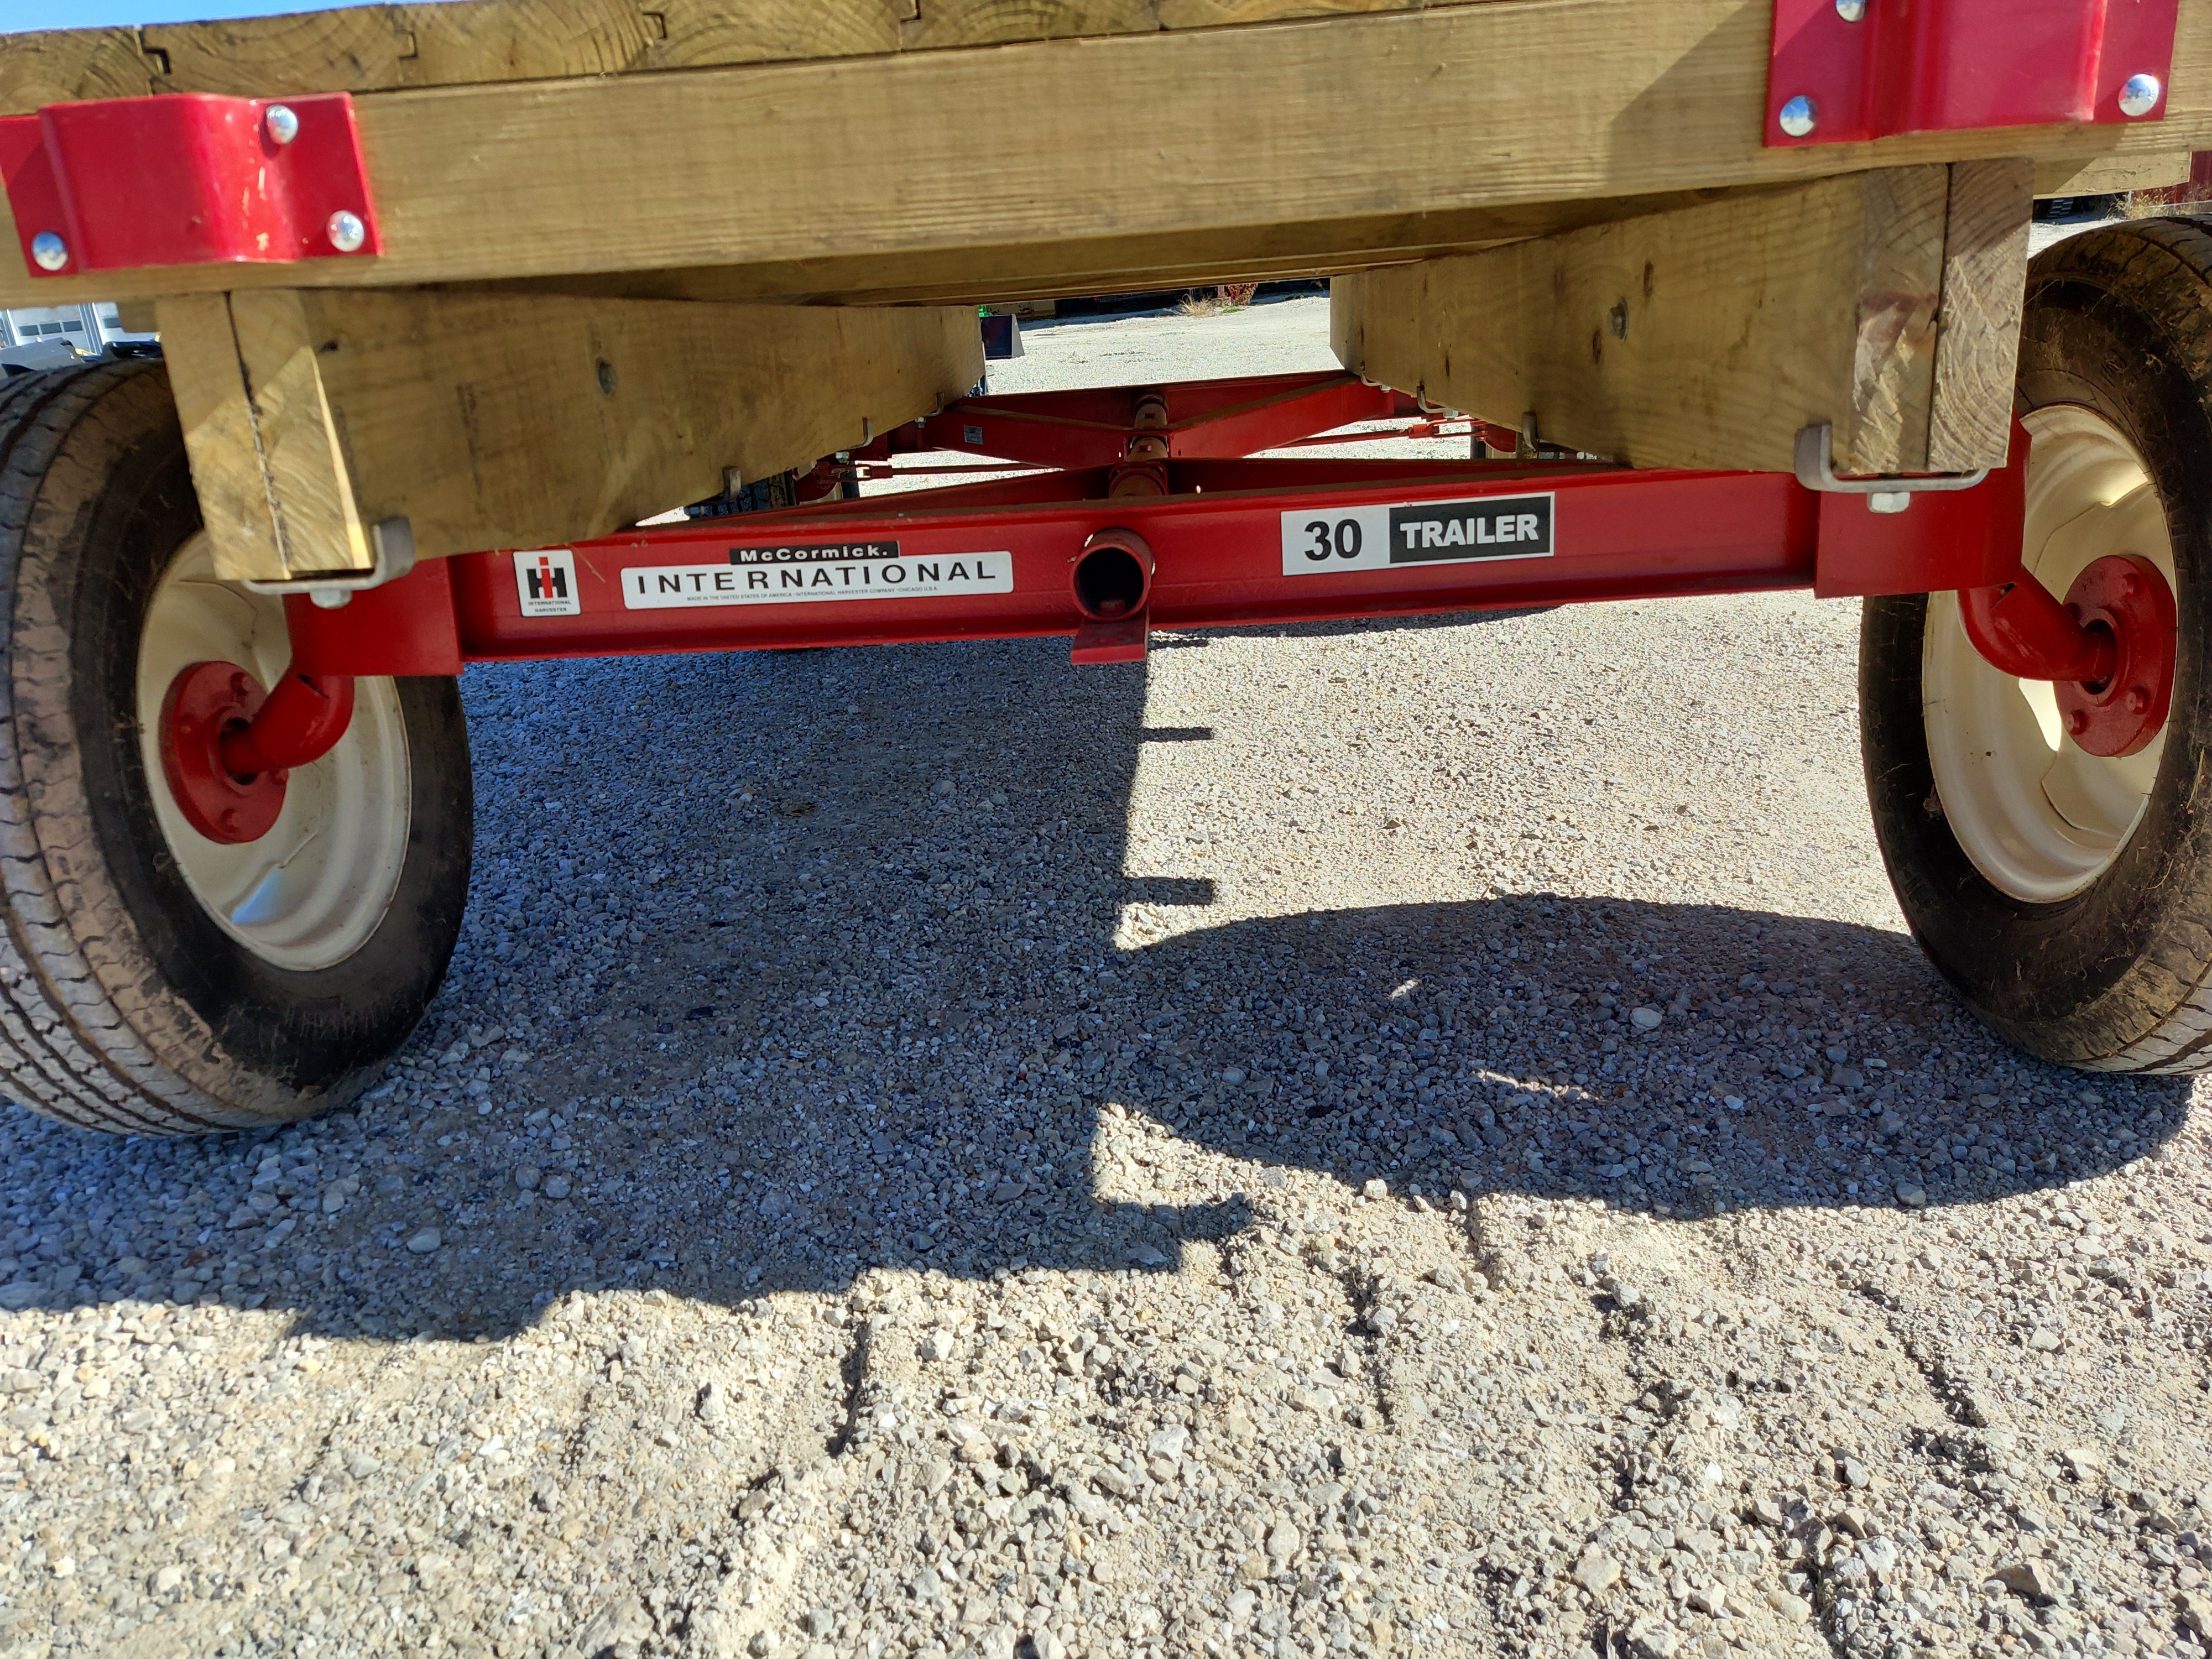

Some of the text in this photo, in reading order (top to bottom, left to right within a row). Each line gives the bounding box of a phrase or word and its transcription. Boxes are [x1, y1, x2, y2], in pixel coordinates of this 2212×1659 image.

[1303, 513, 1539, 561] 30 TRAILER
[638, 561, 996, 594] INTERNATIONAL
